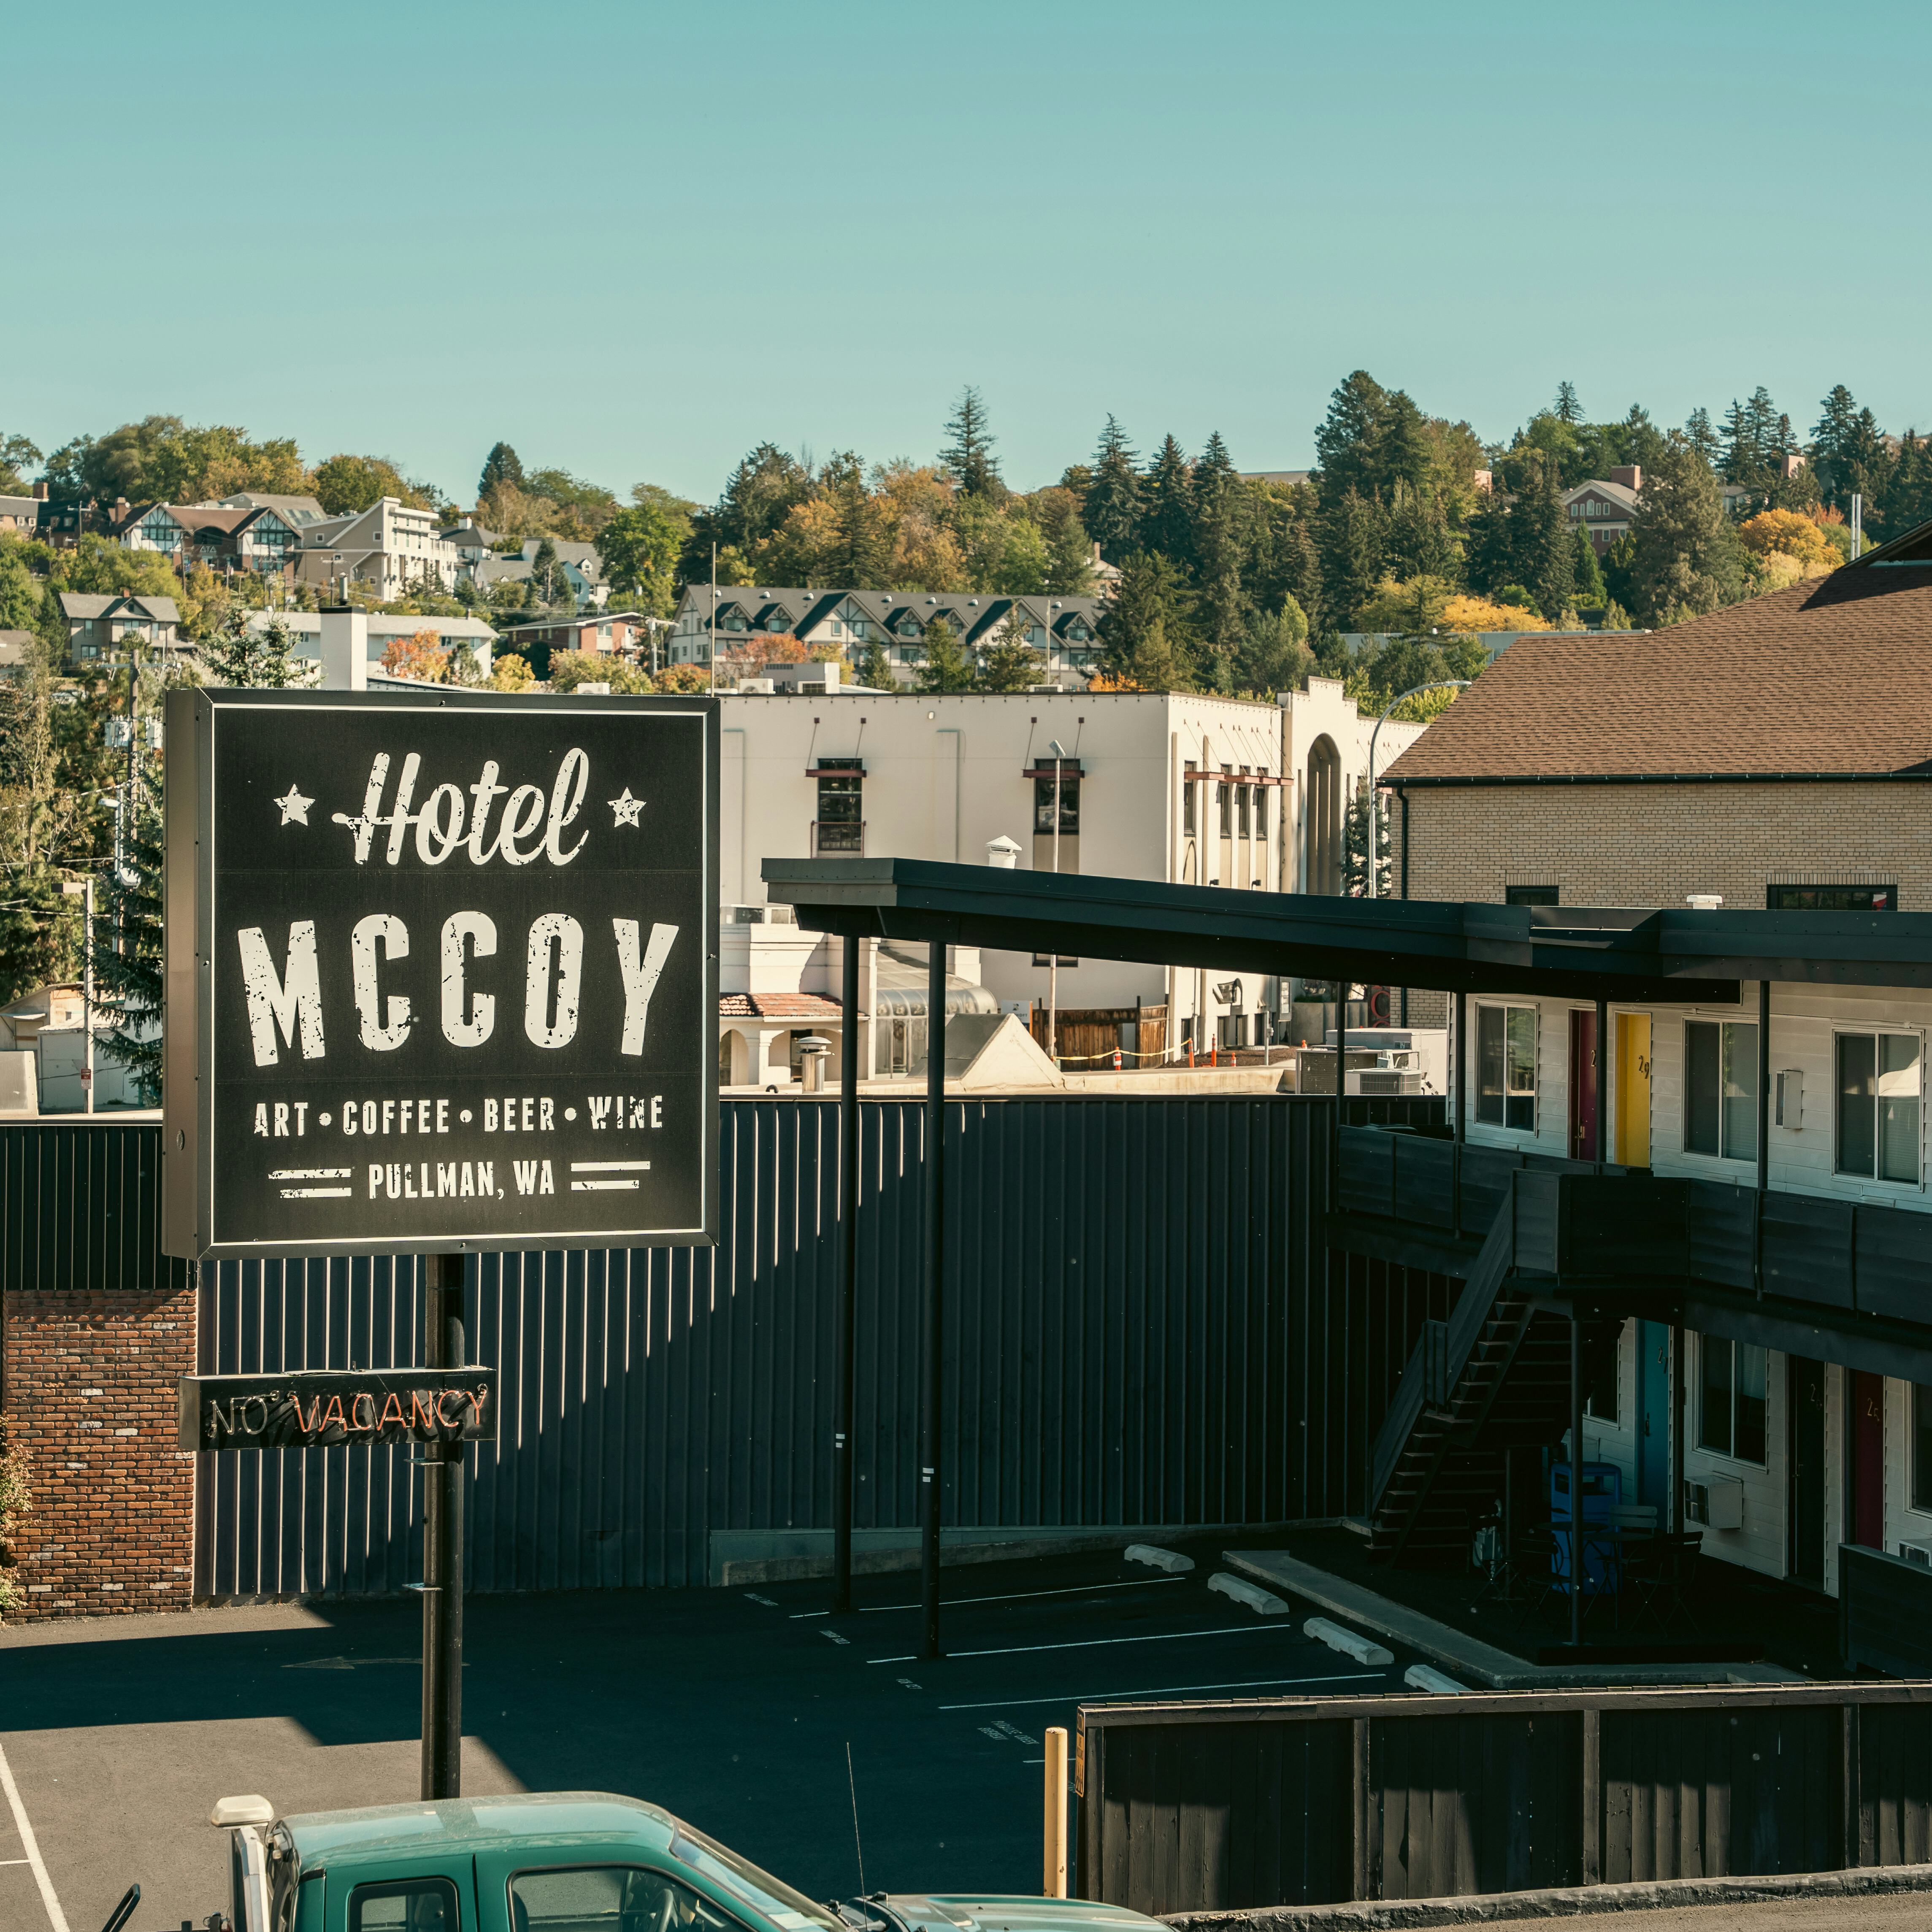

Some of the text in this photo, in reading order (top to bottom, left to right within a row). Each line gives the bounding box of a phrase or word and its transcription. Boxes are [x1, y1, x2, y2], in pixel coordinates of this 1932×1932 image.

[332, 748, 589, 866] Hotel
[238, 911, 679, 1066] MCCOY
[1639, 1055, 1650, 1079] 29
[254, 1096, 662, 1136] ART COFFEE BEER WINE
[369, 1160, 554, 1200] PULLMAN, WA
[1658, 1346, 1669, 1374] 27
[212, 1385, 487, 1435] NO VACANCY
[1867, 1397, 1880, 1423] 25
[990, 1720, 1040, 1745] PARADISE CREEK
